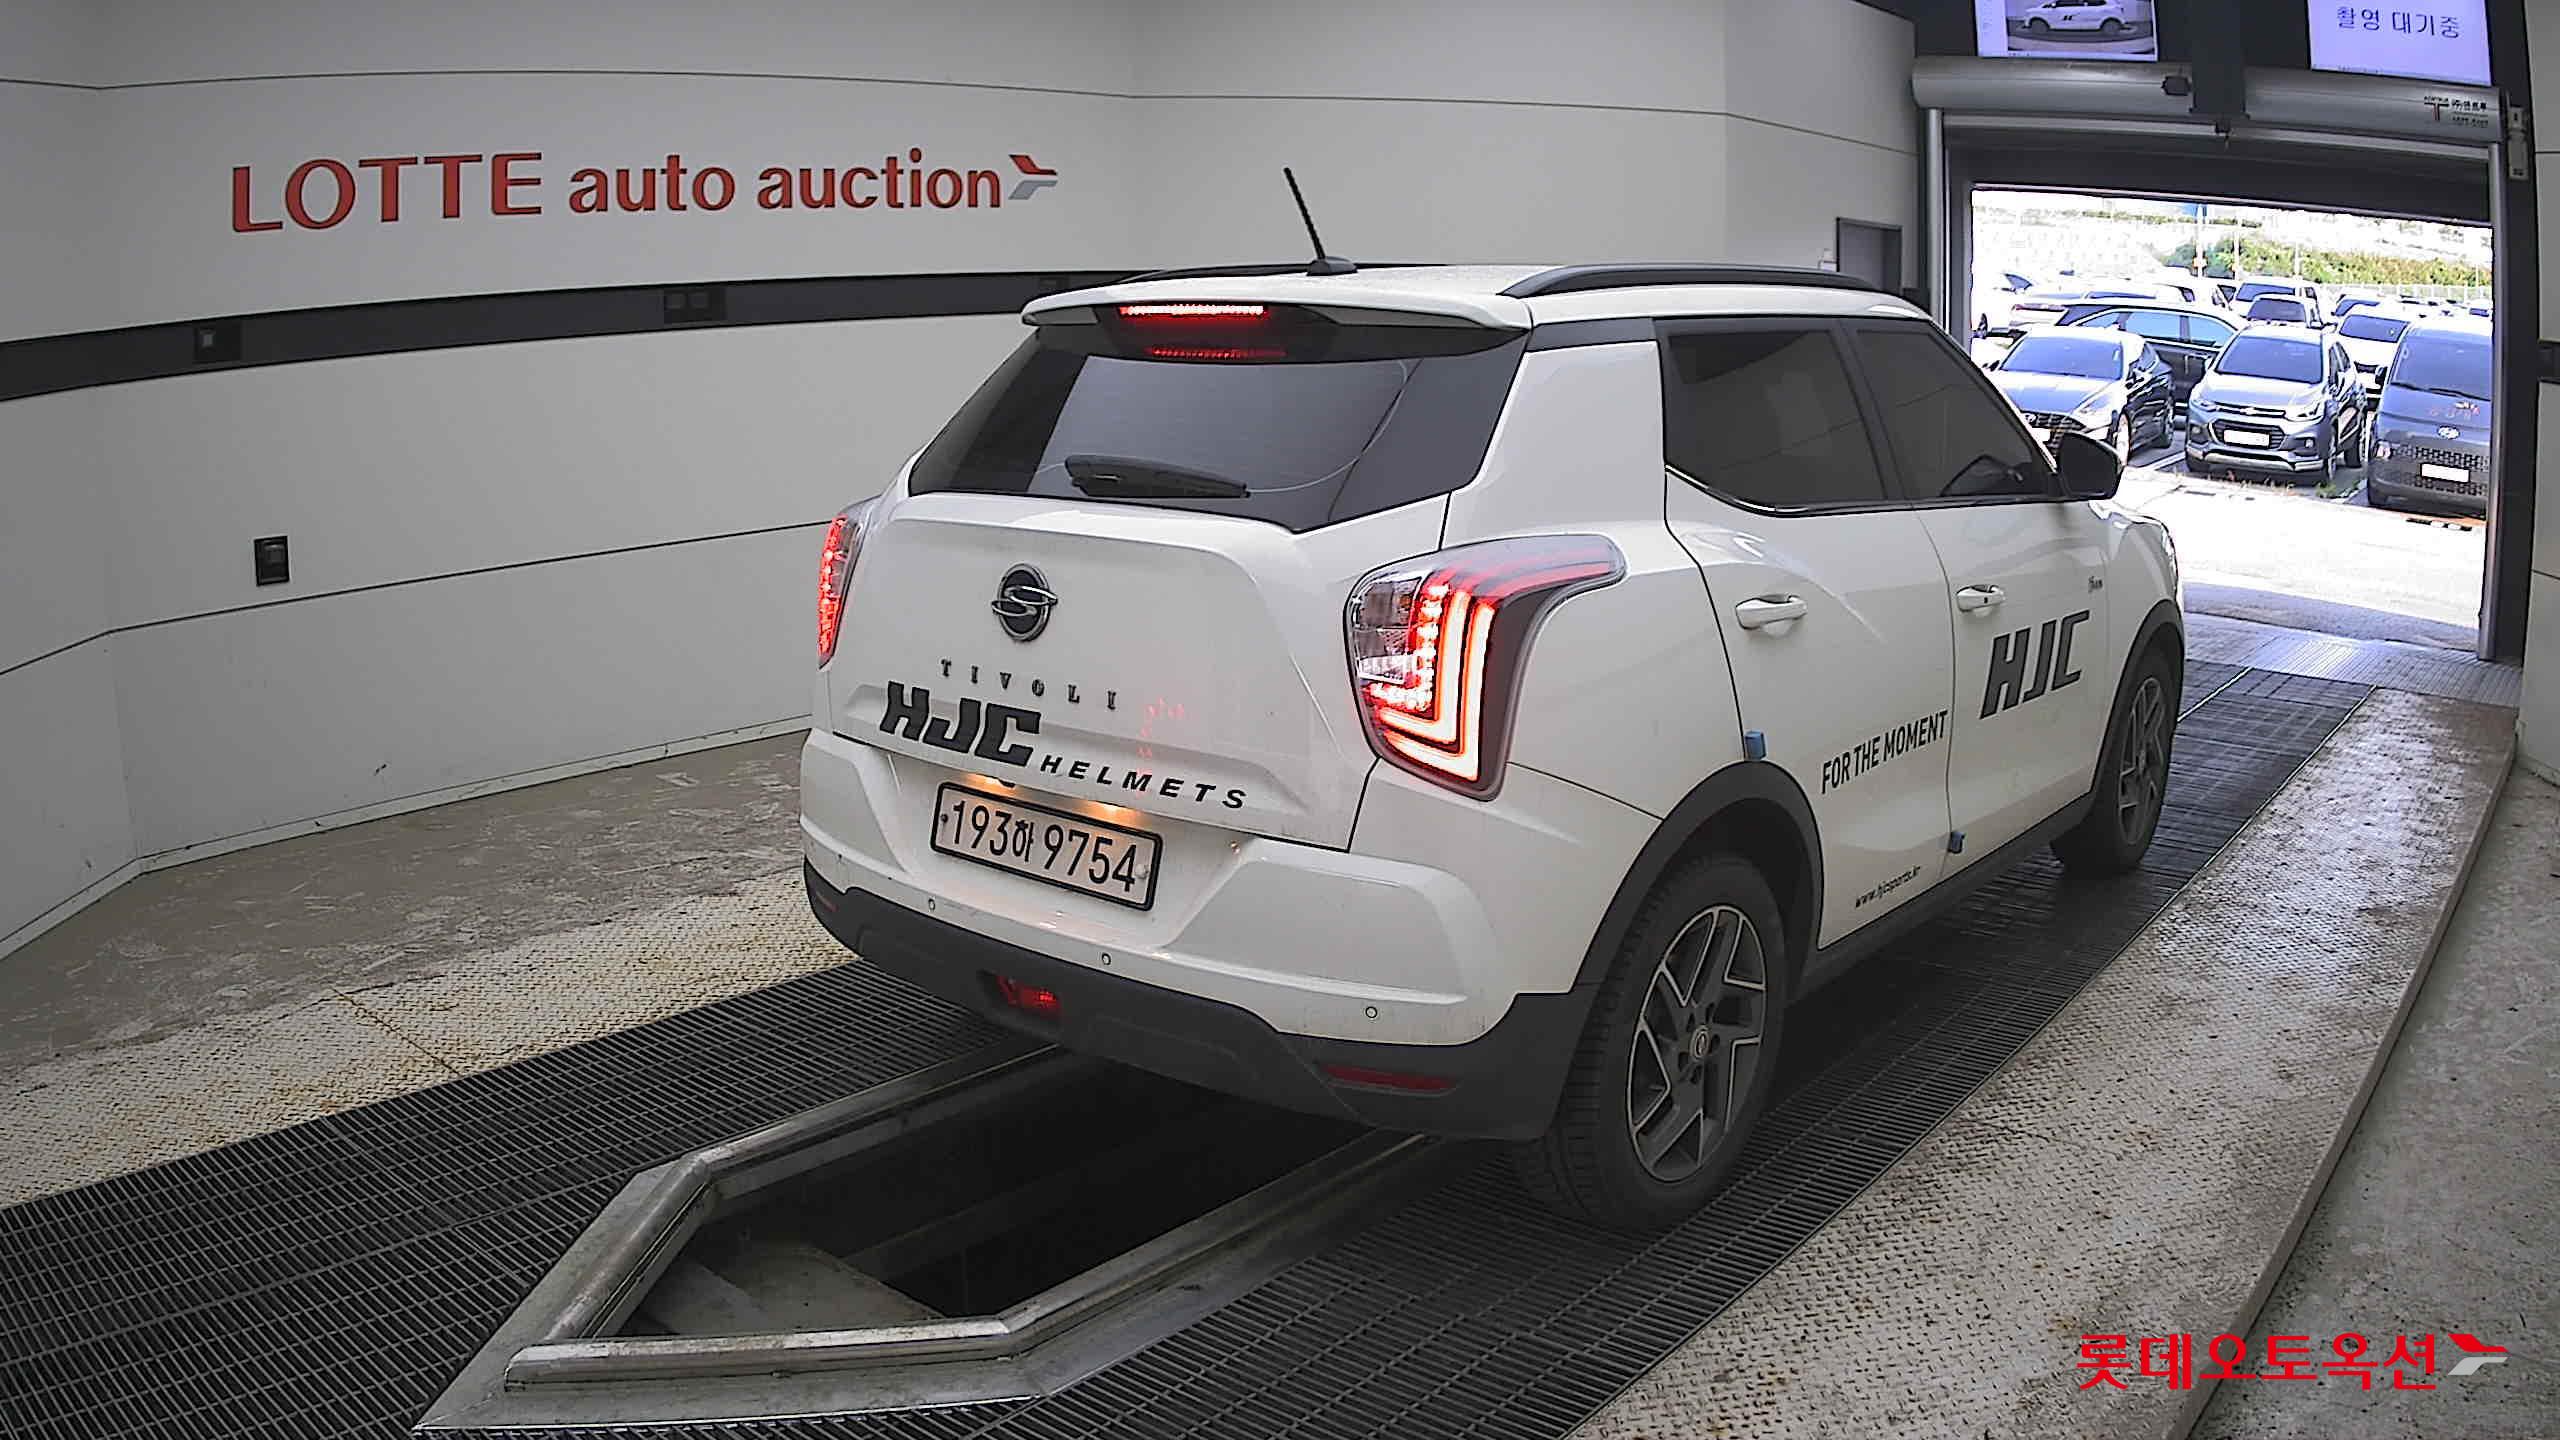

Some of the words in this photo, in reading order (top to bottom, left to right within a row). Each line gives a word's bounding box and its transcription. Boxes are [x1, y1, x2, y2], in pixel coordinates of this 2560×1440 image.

[2337, 6, 2380, 31] 촬영
[2392, 11, 2459, 39] 대기중
[232, 152, 542, 233] LOTTE
[569, 154, 735, 214] auto
[756, 147, 1001, 209] auction
[940, 659, 1117, 711] TIVOLI
[1979, 609, 2090, 720] HJC
[879, 680, 1042, 768] HJC
[1040, 754, 1247, 809] HELMETS
[1821, 752, 1851, 795] FOR
[1853, 735, 1881, 777] THE
[1883, 709, 1949, 762] MOMENT
[953, 800, 1034, 863] 193하
[1044, 823, 1138, 893] 9754
